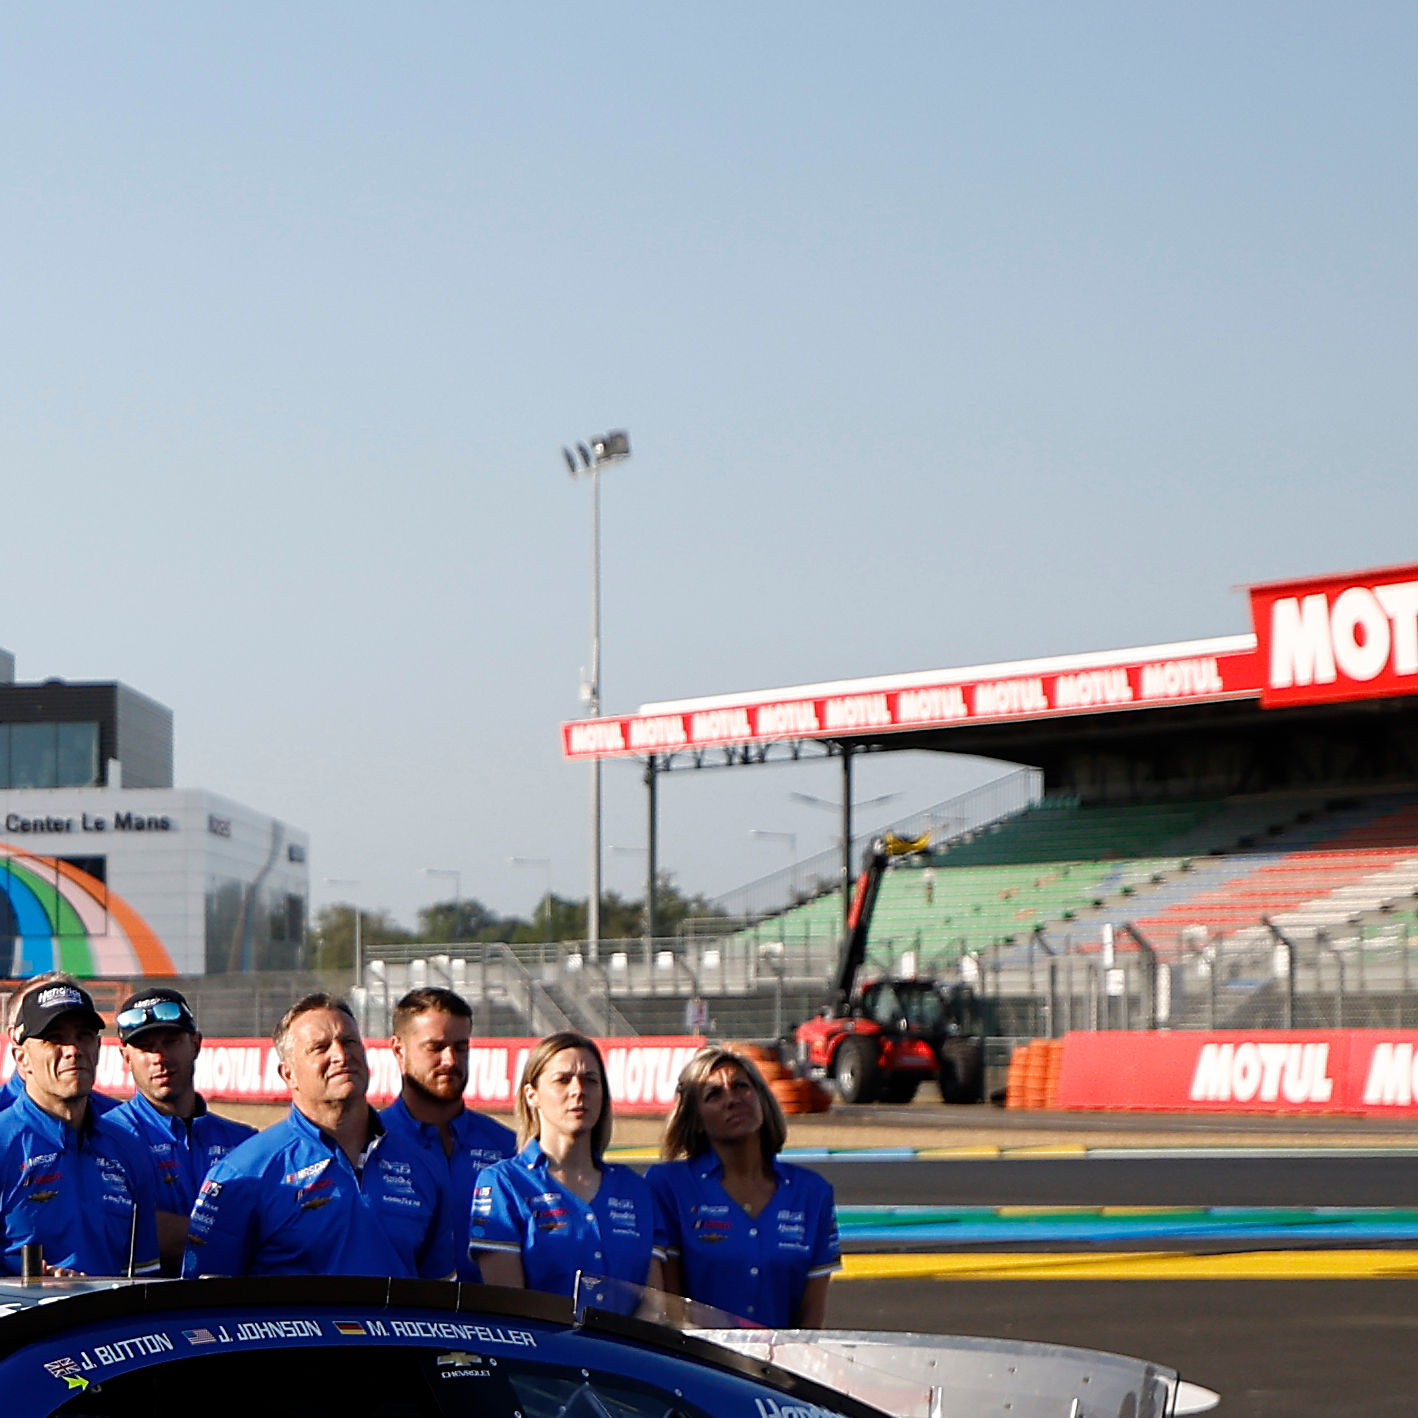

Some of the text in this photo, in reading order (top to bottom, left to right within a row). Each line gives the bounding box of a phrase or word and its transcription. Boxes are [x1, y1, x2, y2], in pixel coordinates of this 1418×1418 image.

[1055, 669, 1133, 708] MOTUL
[1141, 658, 1223, 697] MOTUL
[825, 693, 892, 728] MOTUL
[898, 687, 967, 723] MOTUL
[974, 678, 1048, 714] MOTUL
[628, 715, 688, 747] MOTUL
[691, 708, 752, 742] MOTUL
[756, 700, 820, 736] MOTUL
[570, 721, 625, 752] MOTUL
[6, 814, 71, 833] Center
[82, 812, 105, 831] Le
[114, 812, 171, 831] Mans
[1190, 1042, 1334, 1103] MOTUL
[218, 1320, 322, 1343] J. JOHNSON
[366, 1320, 538, 1348] M. ROCKENFELLER
[80, 1333, 175, 1372] J. BUTTON
[441, 1370, 491, 1380] CHEVROLET
